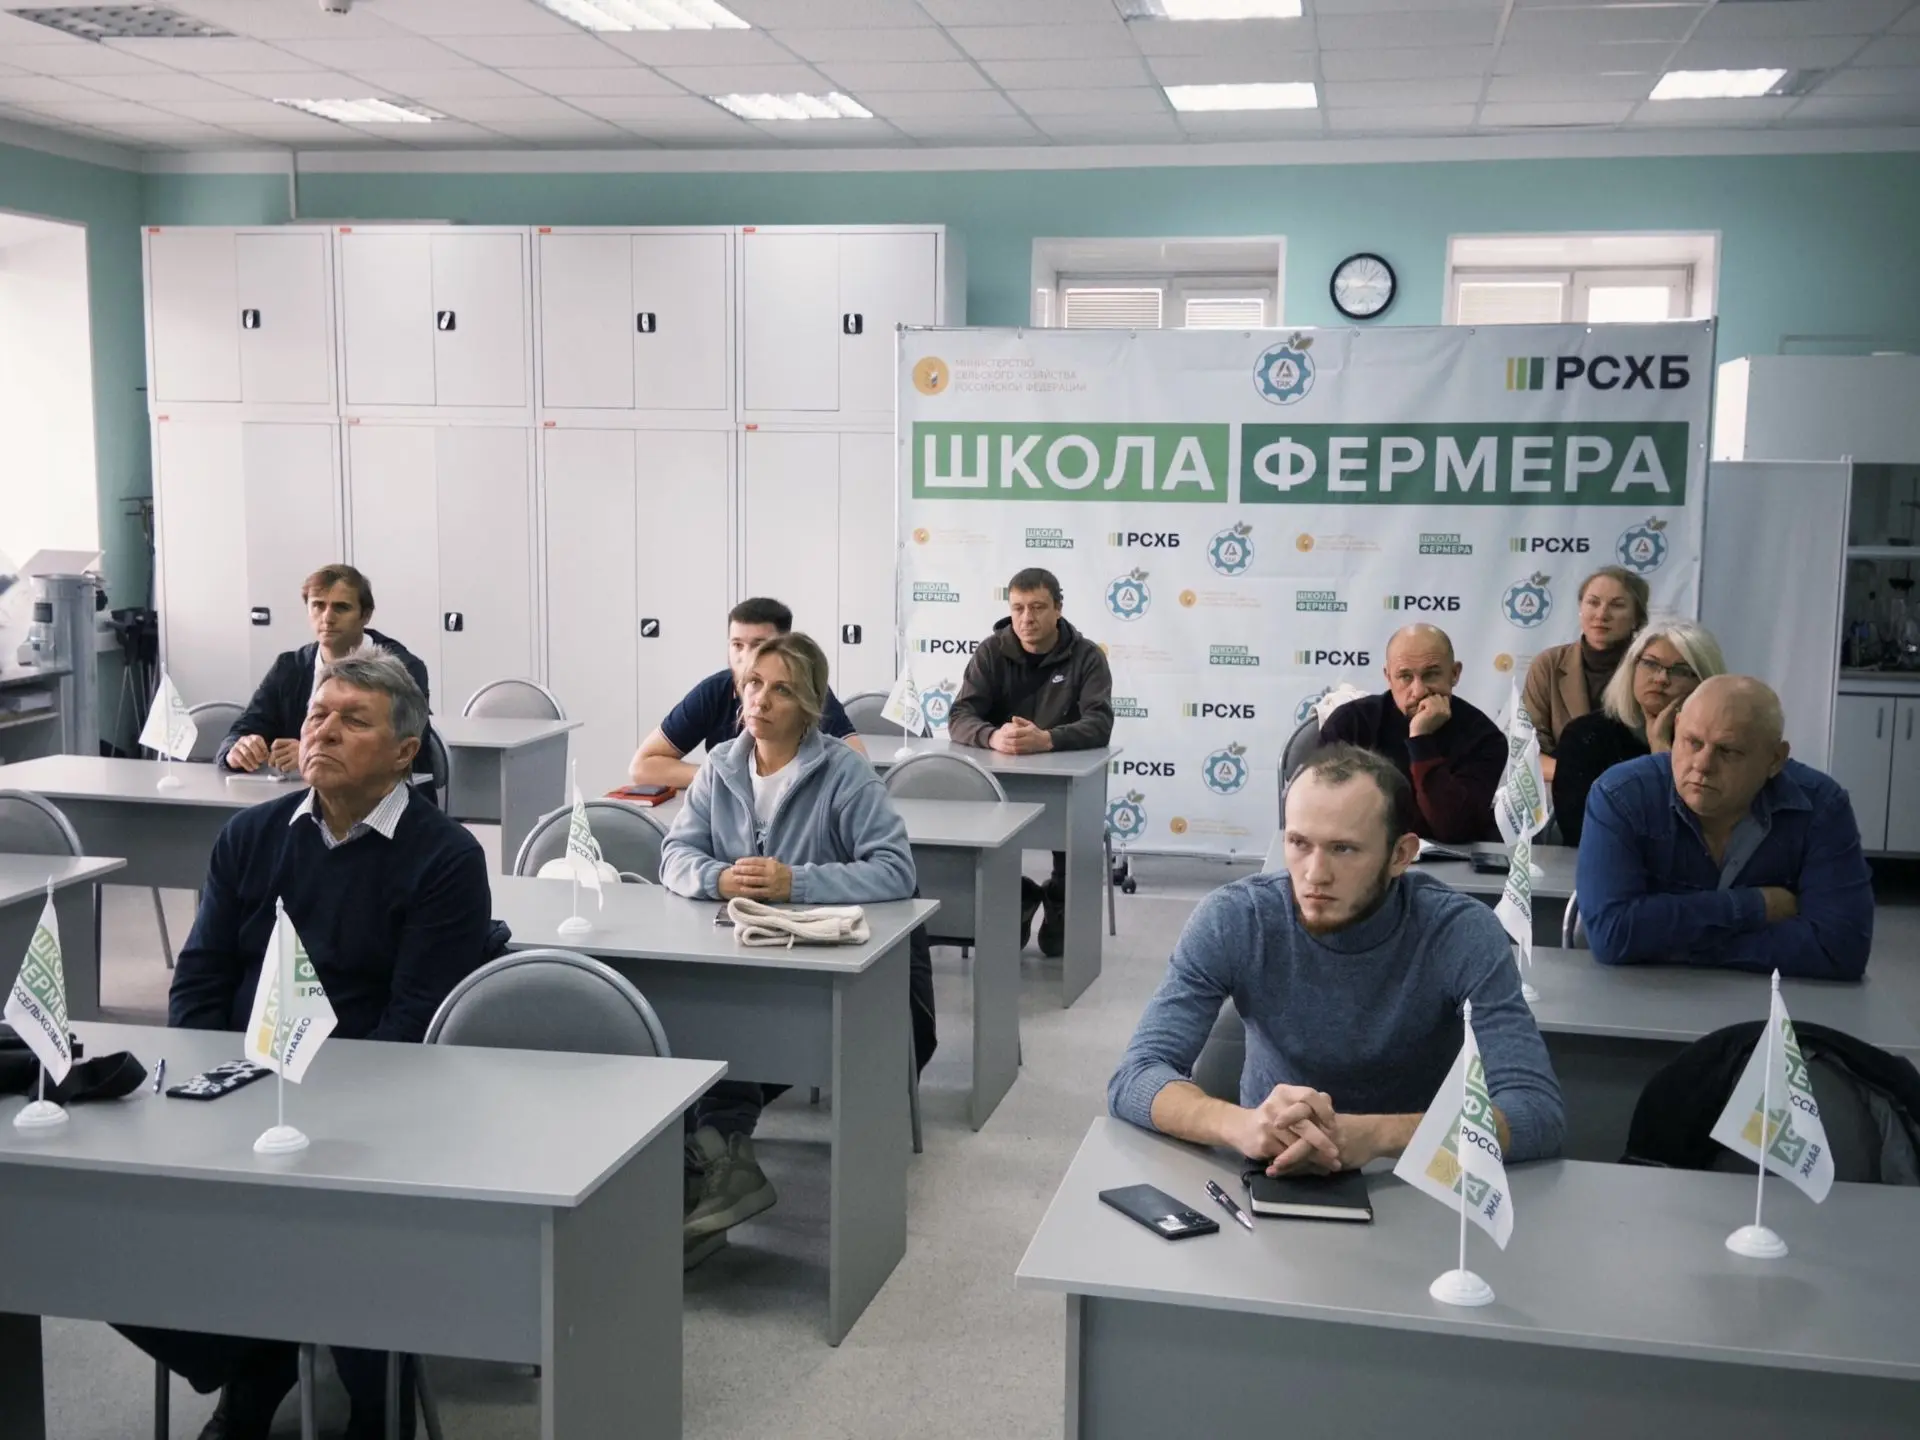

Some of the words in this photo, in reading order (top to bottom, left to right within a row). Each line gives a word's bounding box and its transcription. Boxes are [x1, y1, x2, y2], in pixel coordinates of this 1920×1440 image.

[1556, 355, 1690, 390] РСХБ
[924, 433, 1215, 491] ШКОЛА
[1253, 435, 1671, 494] ФЕРМЕРА
[1027, 529, 1062, 538] ШКОЛА
[1026, 539, 1073, 548] ФЕРМЕРА
[1127, 532, 1180, 548] РСХБ
[1420, 535, 1460, 543] ШКОЛА
[1420, 545, 1472, 554] ФЕРМЕРА
[1531, 537, 1590, 553] РСХБ
[914, 582, 948, 591] ШКОЛА
[914, 592, 959, 602] ФЕРМЕРА
[1298, 592, 1336, 600] ШКОЛА
[1297, 602, 1347, 611] ФЕРМЕРА
[1404, 596, 1461, 611] РСХБ
[1211, 646, 1247, 654] ШКОЛА
[1210, 656, 1258, 665] ФЕРМЕРА
[1315, 651, 1370, 666] РСХБ
[1111, 699, 1136, 707] КОЛА
[1112, 708, 1147, 717] РМЕРА
[1202, 703, 1255, 719] РСХБ
[1123, 761, 1176, 777] РСХБ
[31, 927, 64, 985] ШКО
[14, 983, 69, 1061] ССЕЛЬХОЗБАНК
